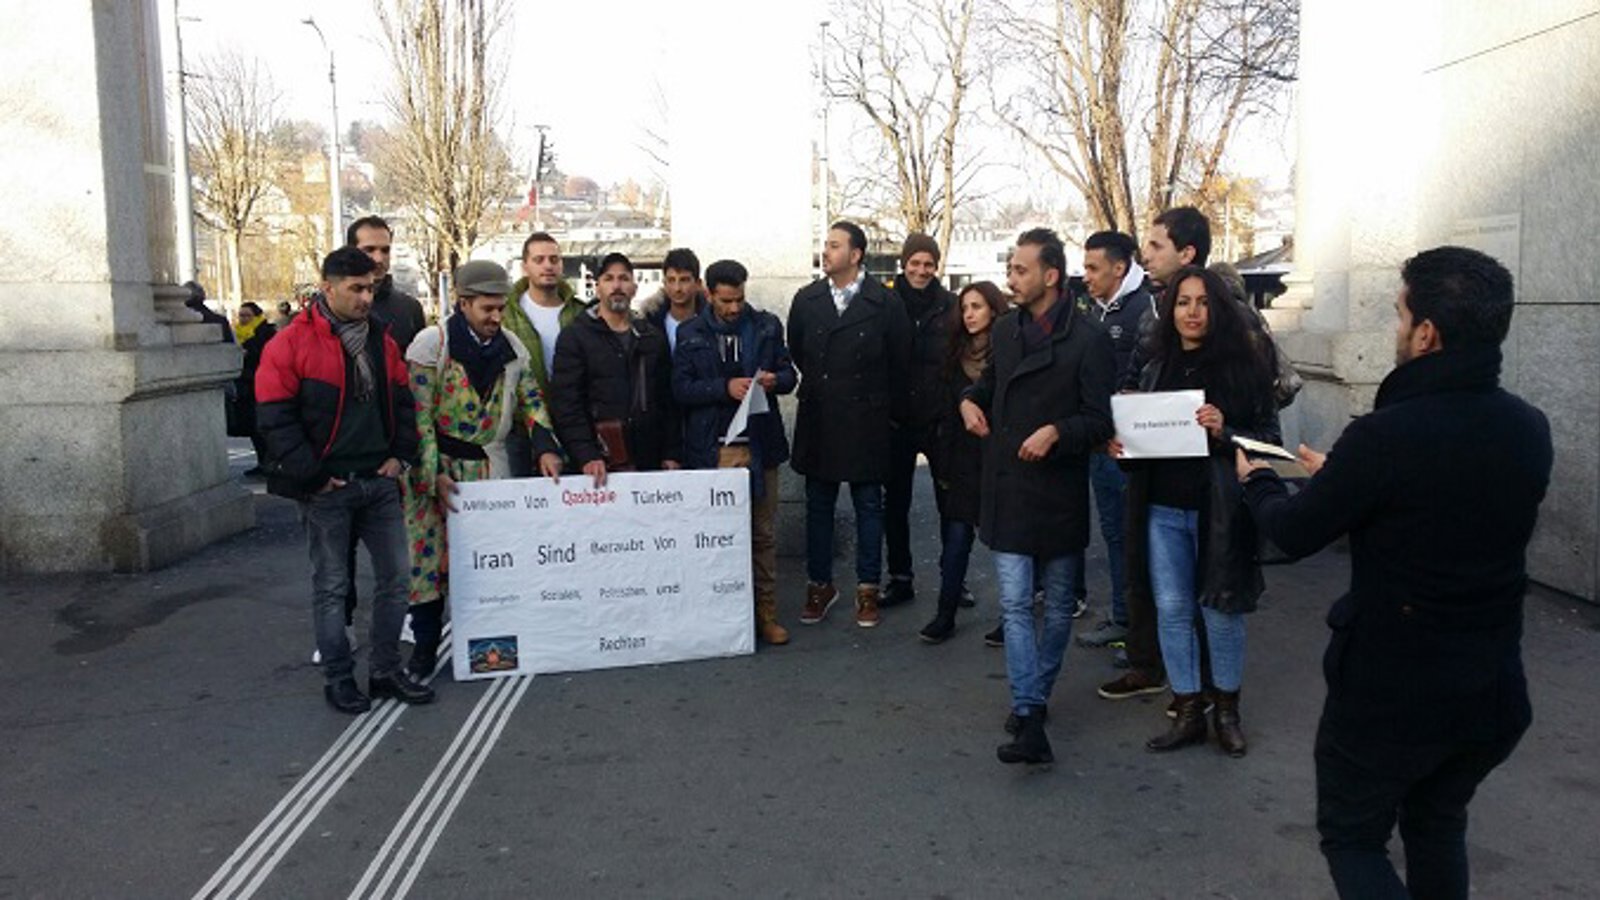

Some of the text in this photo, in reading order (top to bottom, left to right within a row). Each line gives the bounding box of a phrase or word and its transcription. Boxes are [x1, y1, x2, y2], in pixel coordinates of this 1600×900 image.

[523, 495, 549, 510] Von
[631, 488, 684, 505] Türken
[710, 487, 736, 507] Im
[473, 531, 735, 570] Iran Sind Beraubt Von Ihrer
[656, 583, 681, 596] und
[599, 635, 646, 652] Rechten
